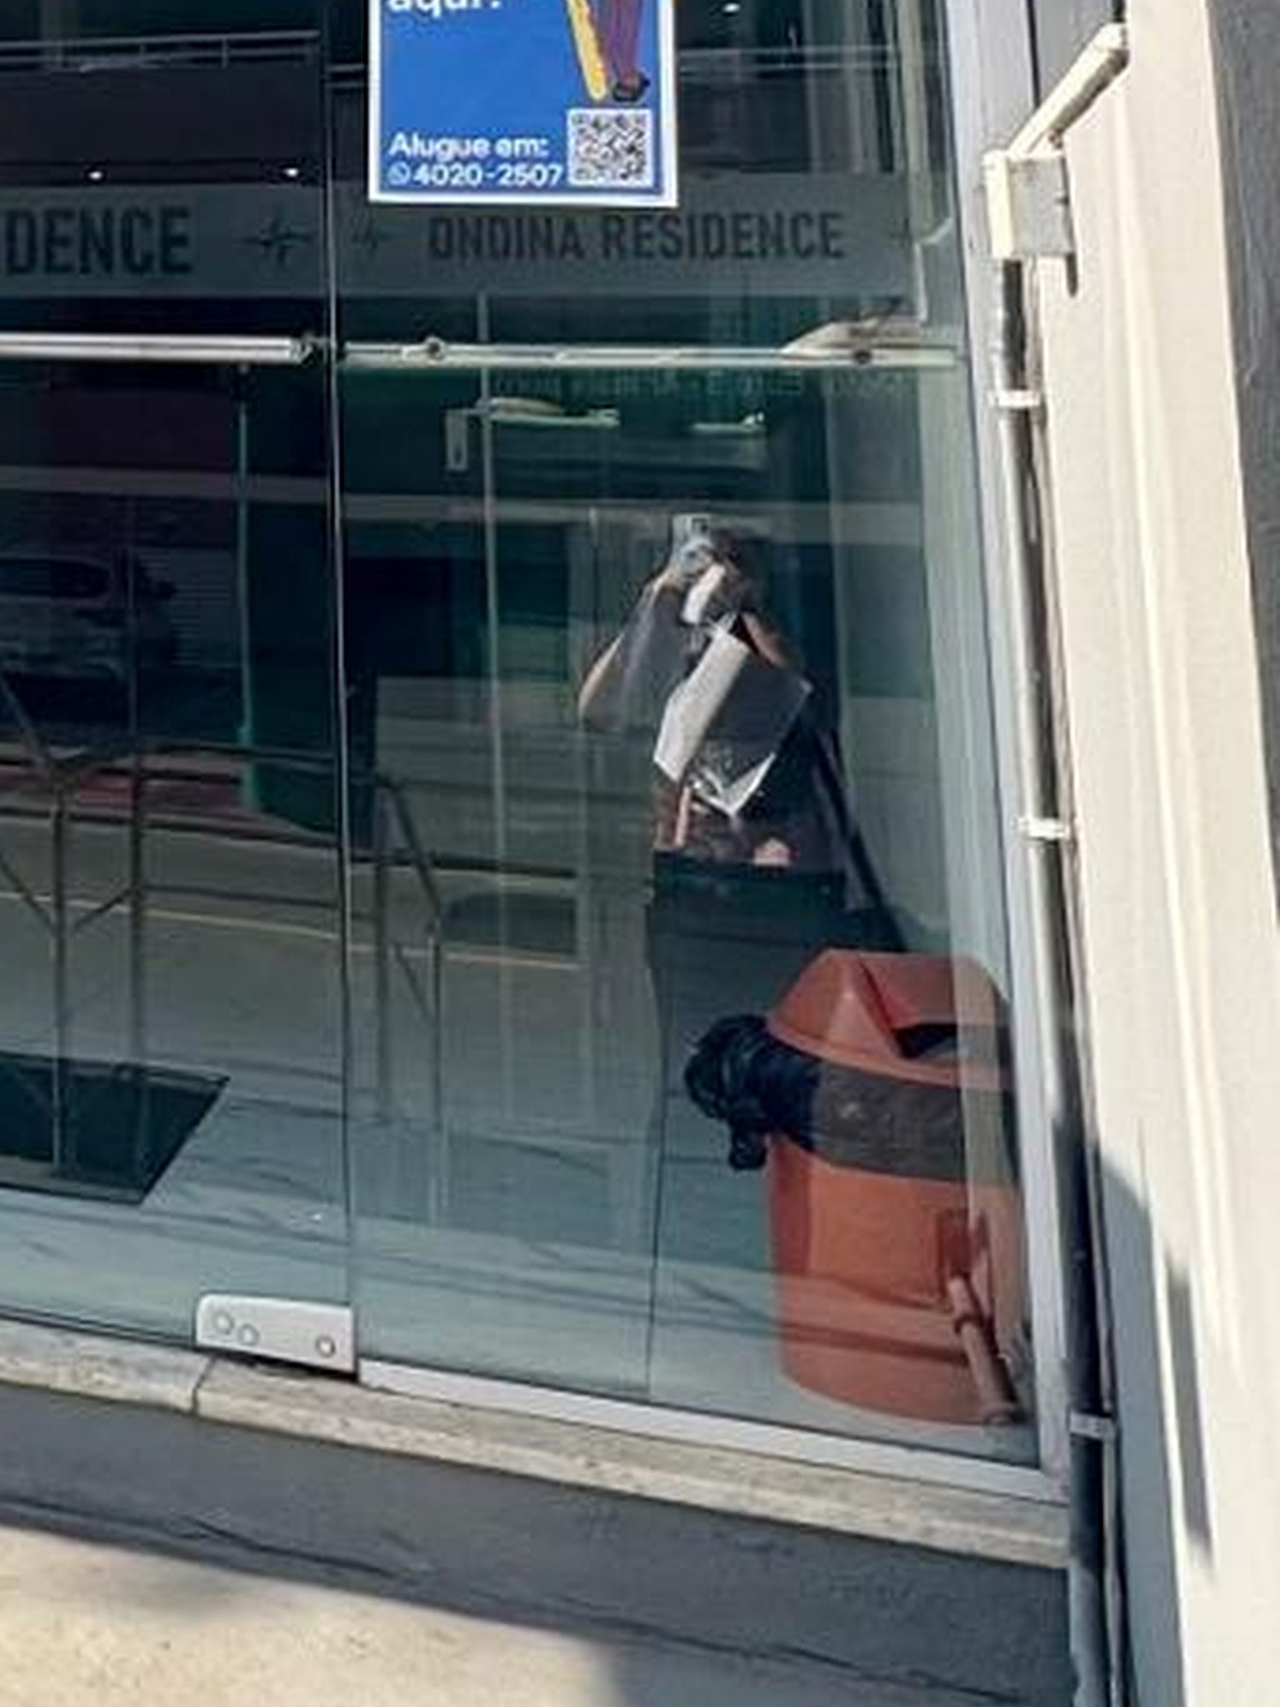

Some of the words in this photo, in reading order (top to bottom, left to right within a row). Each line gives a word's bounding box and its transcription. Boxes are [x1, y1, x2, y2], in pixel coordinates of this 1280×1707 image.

[388, 133, 490, 160] Alugue
[495, 137, 549, 158] em:
[427, 214, 585, 260] ONDINA
[599, 211, 846, 260] RESIDENCE
